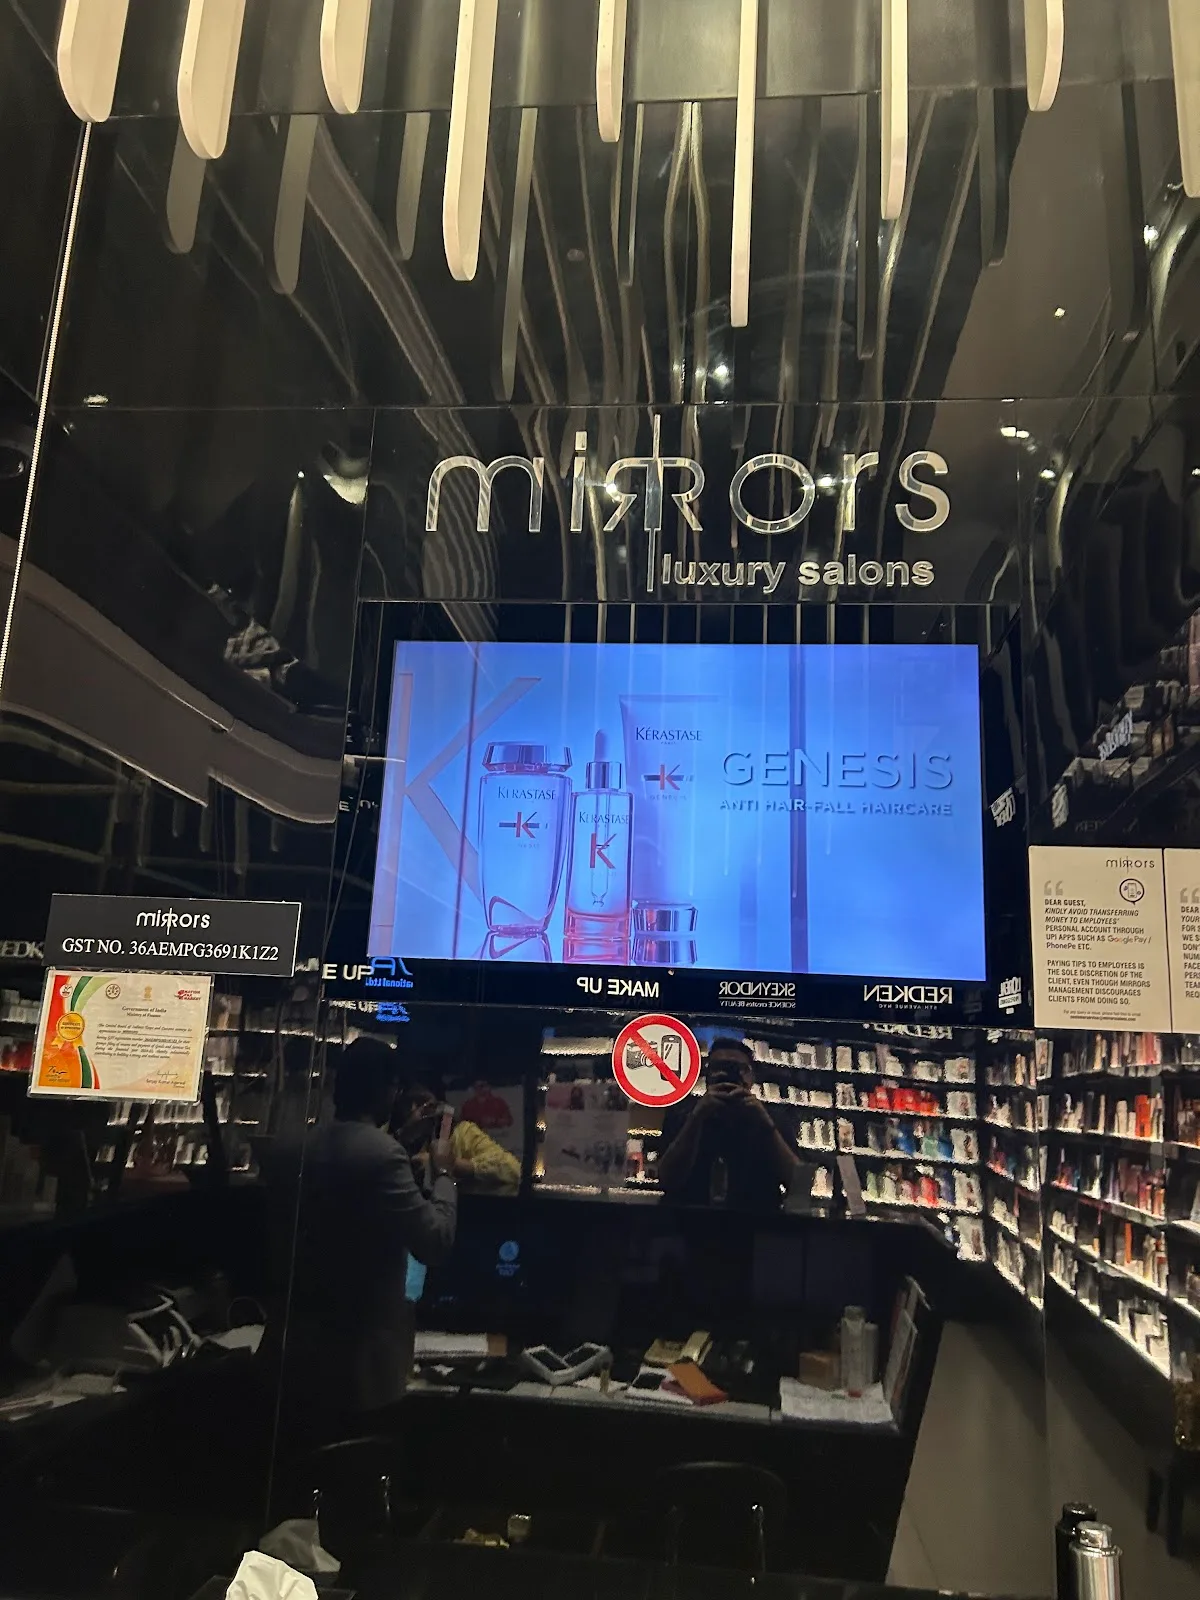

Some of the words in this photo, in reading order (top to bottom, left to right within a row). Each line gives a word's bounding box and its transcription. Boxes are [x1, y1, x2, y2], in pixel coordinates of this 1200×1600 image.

[661, 553, 786, 594] luxury
[798, 554, 935, 586] salons
[723, 749, 953, 790] GENESIS
[719, 799, 758, 812] ANTI
[861, 801, 953, 817] HAIRCARE
[1063, 899, 1086, 907] GUEST,
[1044, 907, 1068, 915] KINDLY
[1068, 908, 1088, 916] AVOID
[1089, 908, 1139, 917] TRANSFERRING
[1045, 916, 1068, 924] MONEY
[1069, 916, 1078, 924] TO
[1080, 926, 1111, 934] ACCOUNT
[1112, 926, 1144, 934] THROUGH
[1076, 934, 1095, 942] SUCH
[1107, 935, 1133, 944] Google
[1182, 934, 1194, 942] WE
[62, 938, 95, 953] GST
[97, 939, 125, 954] NO.
[129, 941, 279, 961] 36AEMPG3691K1Z2
[1046, 941, 1076, 949] PhonePe
[1047, 959, 1070, 967] PAYING
[1071, 960, 1086, 968] TIPS
[1088, 960, 1097, 968] TO
[1098, 961, 1137, 969] EMPLOYEES
[1137, 962, 1145, 970] IS
[343, 964, 375, 980] UP
[1047, 968, 1060, 976] THE
[1079, 969, 1118, 978] DISCRETION
[1130, 971, 1143, 979] THE
[1047, 977, 1072, 986] CLIENT,
[1073, 978, 1090, 986] EVEN
[1091, 979, 1118, 987] THOUGH
[1120, 980, 1151, 988] MIRRORS
[1048, 986, 1094, 995] MANAGEMENT
[1095, 988, 1141, 996] DISCOURAGES
[1048, 995, 1075, 1003] CLIENTS
[1076, 996, 1096, 1004] FROM
[1119, 997, 1131, 1005] SO.
